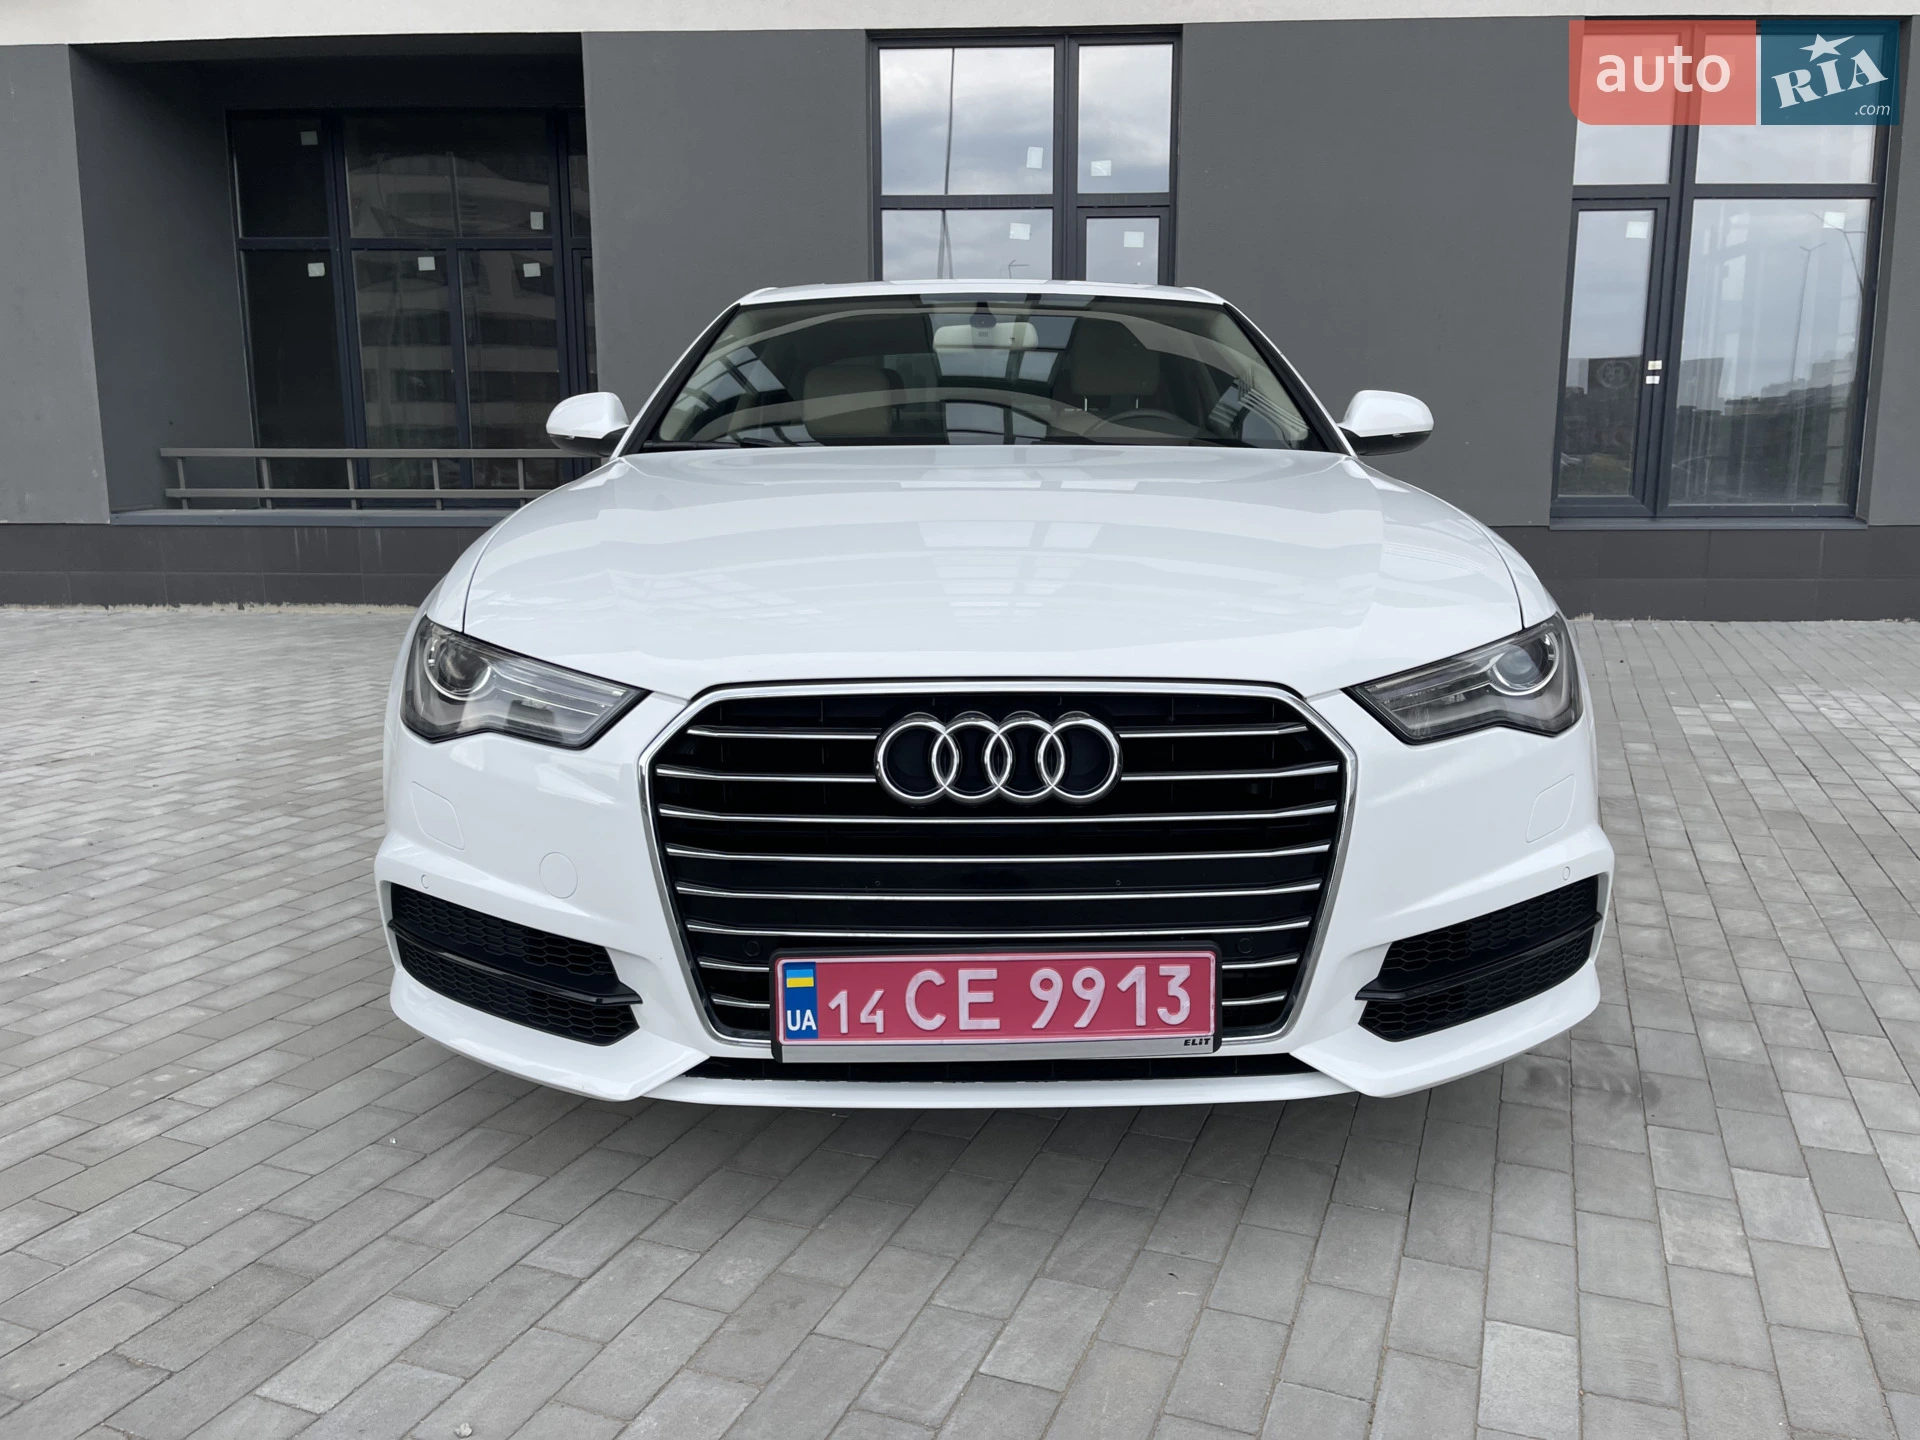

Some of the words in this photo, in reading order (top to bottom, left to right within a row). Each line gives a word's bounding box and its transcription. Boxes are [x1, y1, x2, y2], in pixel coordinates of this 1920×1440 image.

[786, 1009, 817, 1031] UA
[828, 989, 885, 1034] 14
[905, 968, 1000, 1031] CE
[1029, 965, 1191, 1029] 9913
